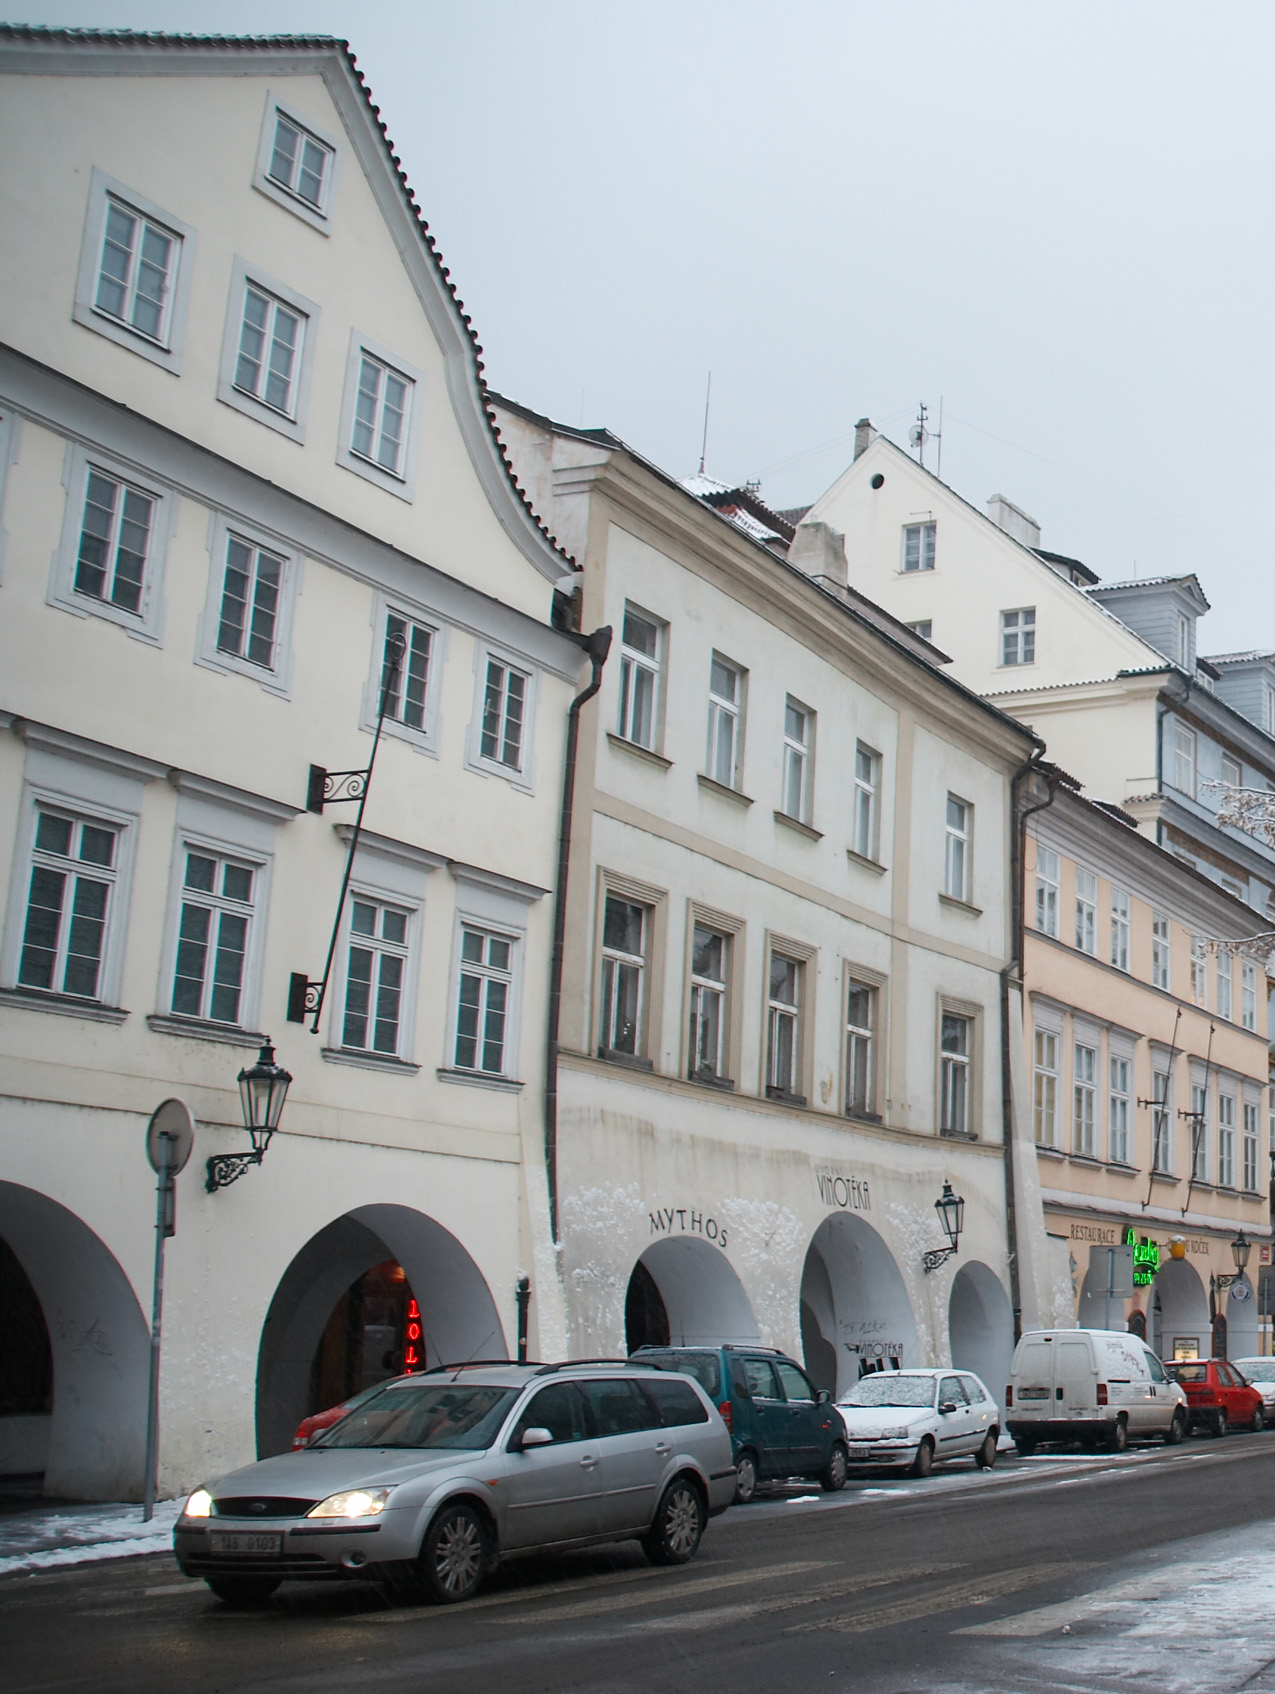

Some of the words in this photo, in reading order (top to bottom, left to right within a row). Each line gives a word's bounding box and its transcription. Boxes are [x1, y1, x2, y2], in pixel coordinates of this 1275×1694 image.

[816, 1174, 871, 1211] VINOTÉKA
[649, 1208, 728, 1247] MYTHOS
[1070, 1224, 1115, 1244] RESTAURACE
[860, 1341, 904, 1356] VINOTÉKA
